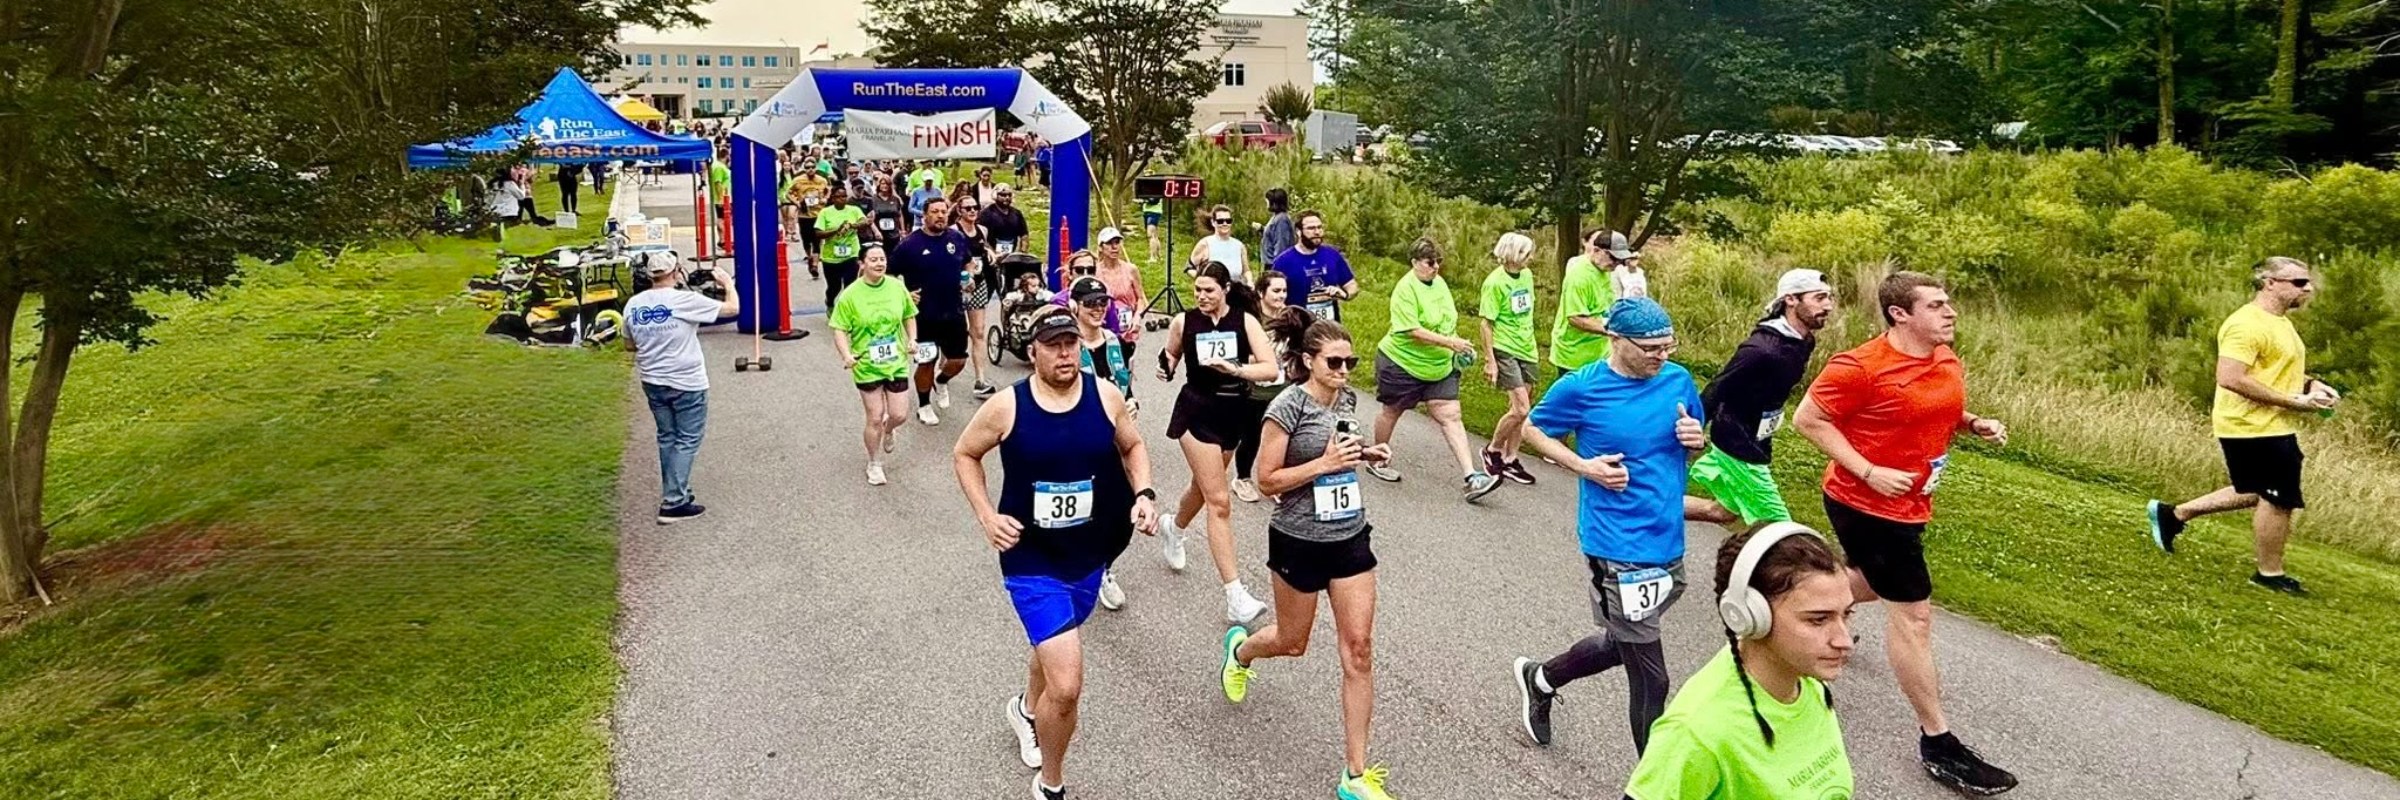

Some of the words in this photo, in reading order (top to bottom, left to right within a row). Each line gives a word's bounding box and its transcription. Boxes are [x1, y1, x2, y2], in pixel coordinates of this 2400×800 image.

[853, 82, 986, 97] RunTheEast.com
[559, 118, 593, 130] Run
[559, 129, 590, 138] The
[592, 129, 627, 138] East
[913, 120, 991, 148] FINISH
[1164, 180, 1200, 197] 0:13
[878, 345, 892, 358] 94
[919, 347, 931, 359] 95
[1208, 340, 1226, 358] 73
[1330, 486, 1350, 510] 15
[1051, 495, 1077, 519] 38
[1638, 581, 1659, 609] 37
